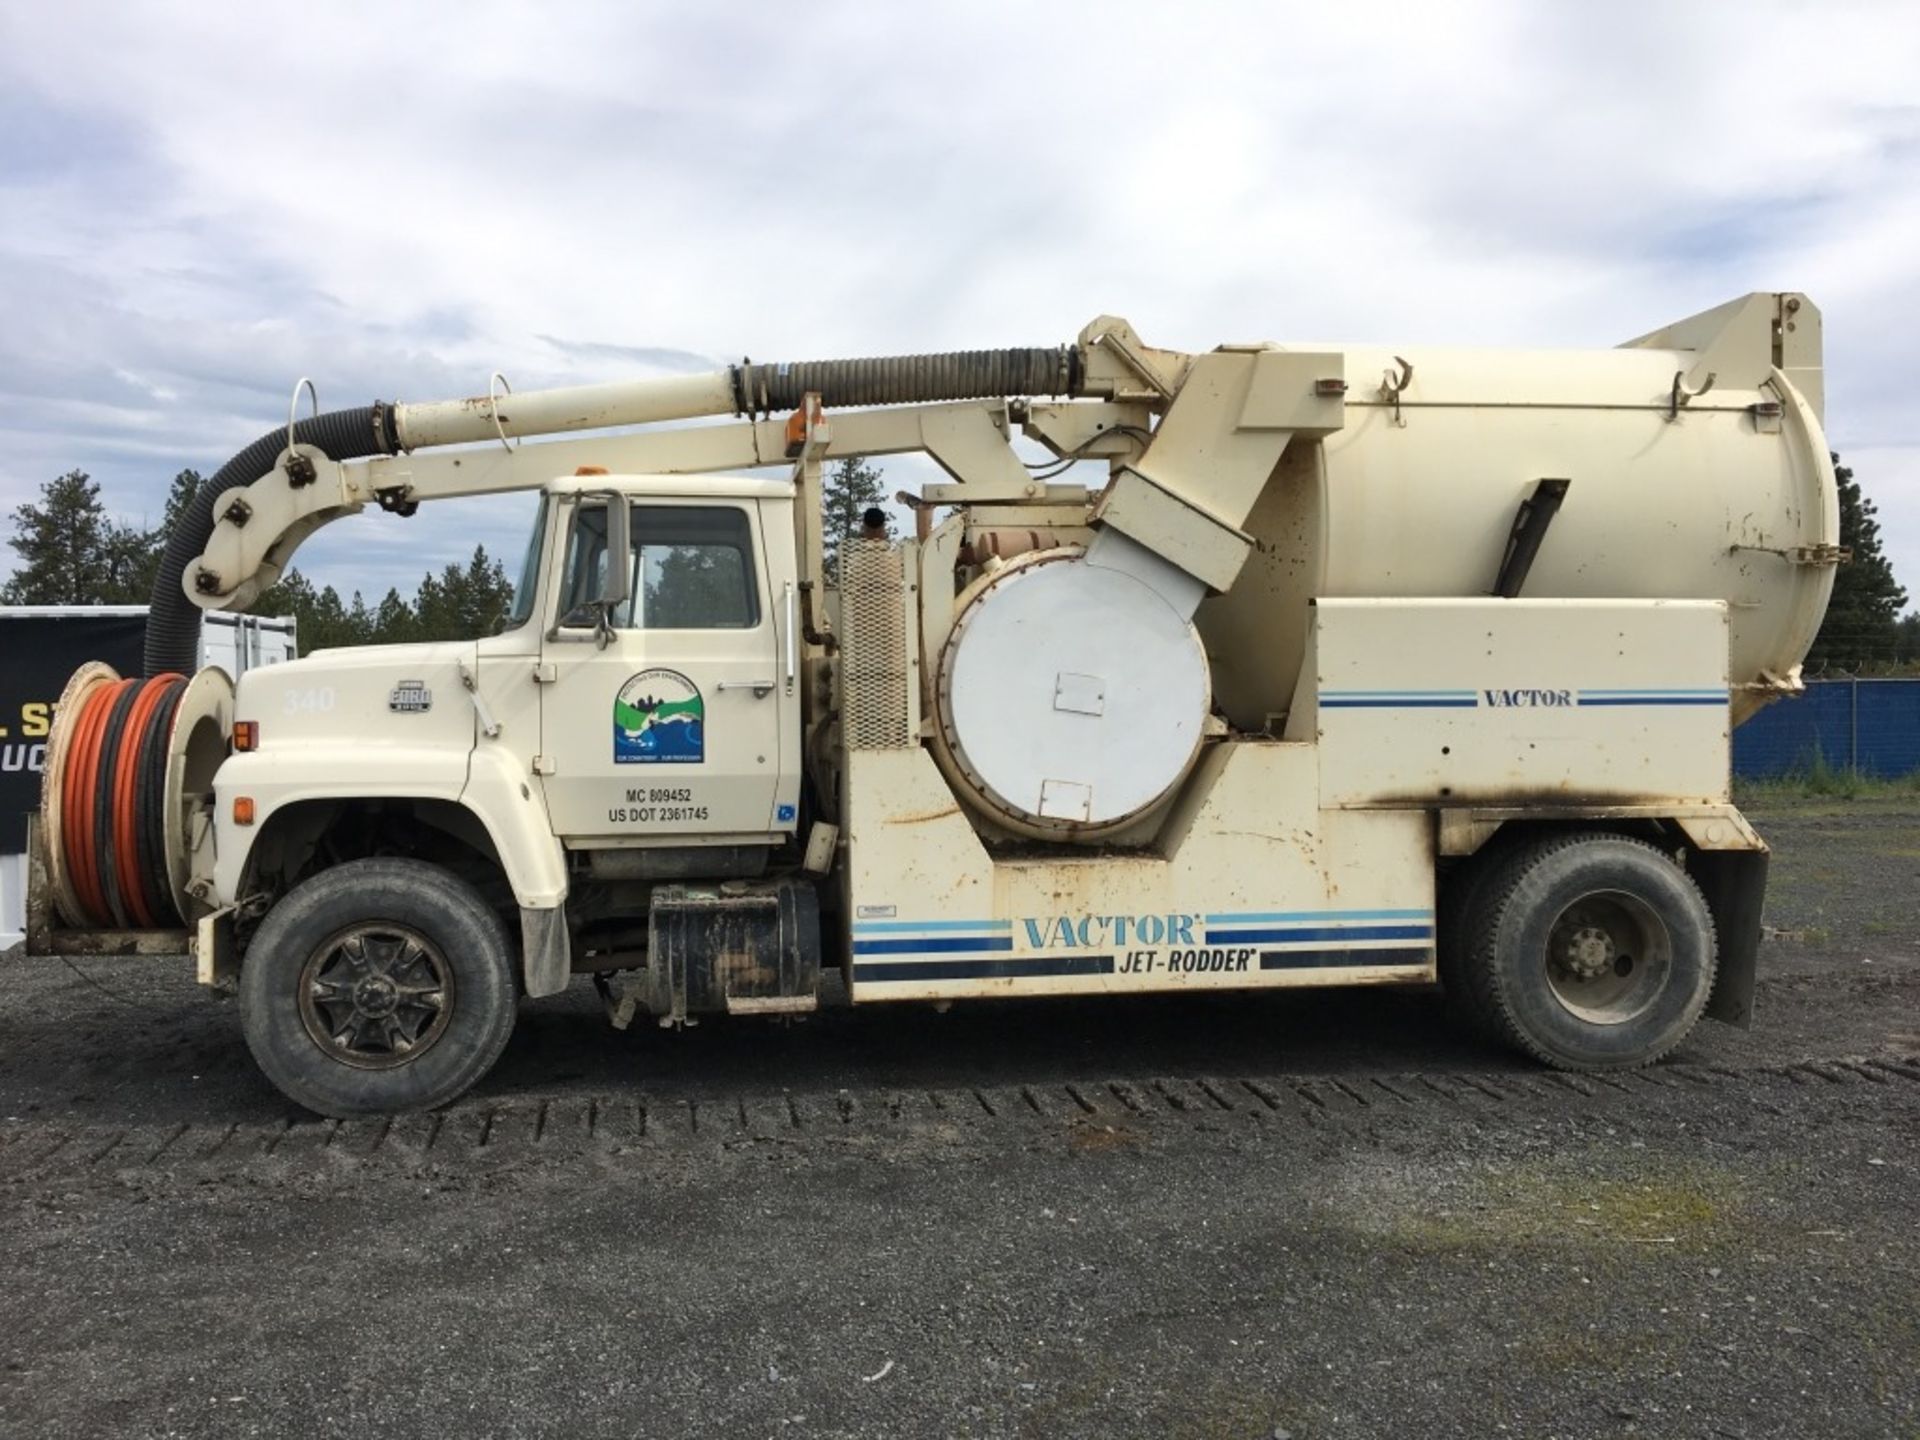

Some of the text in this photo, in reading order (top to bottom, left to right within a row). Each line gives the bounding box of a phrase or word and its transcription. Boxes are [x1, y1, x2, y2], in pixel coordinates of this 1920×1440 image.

[283, 688, 335, 715] 340
[389, 690, 431, 703] FORD
[1484, 690, 1572, 707] VACTOR
[626, 789, 691, 802] MC 809452
[609, 807, 708, 822] US DOT 2361745
[1022, 914, 1195, 948] VACTOR
[1119, 950, 1249, 973] JET-RODDER
